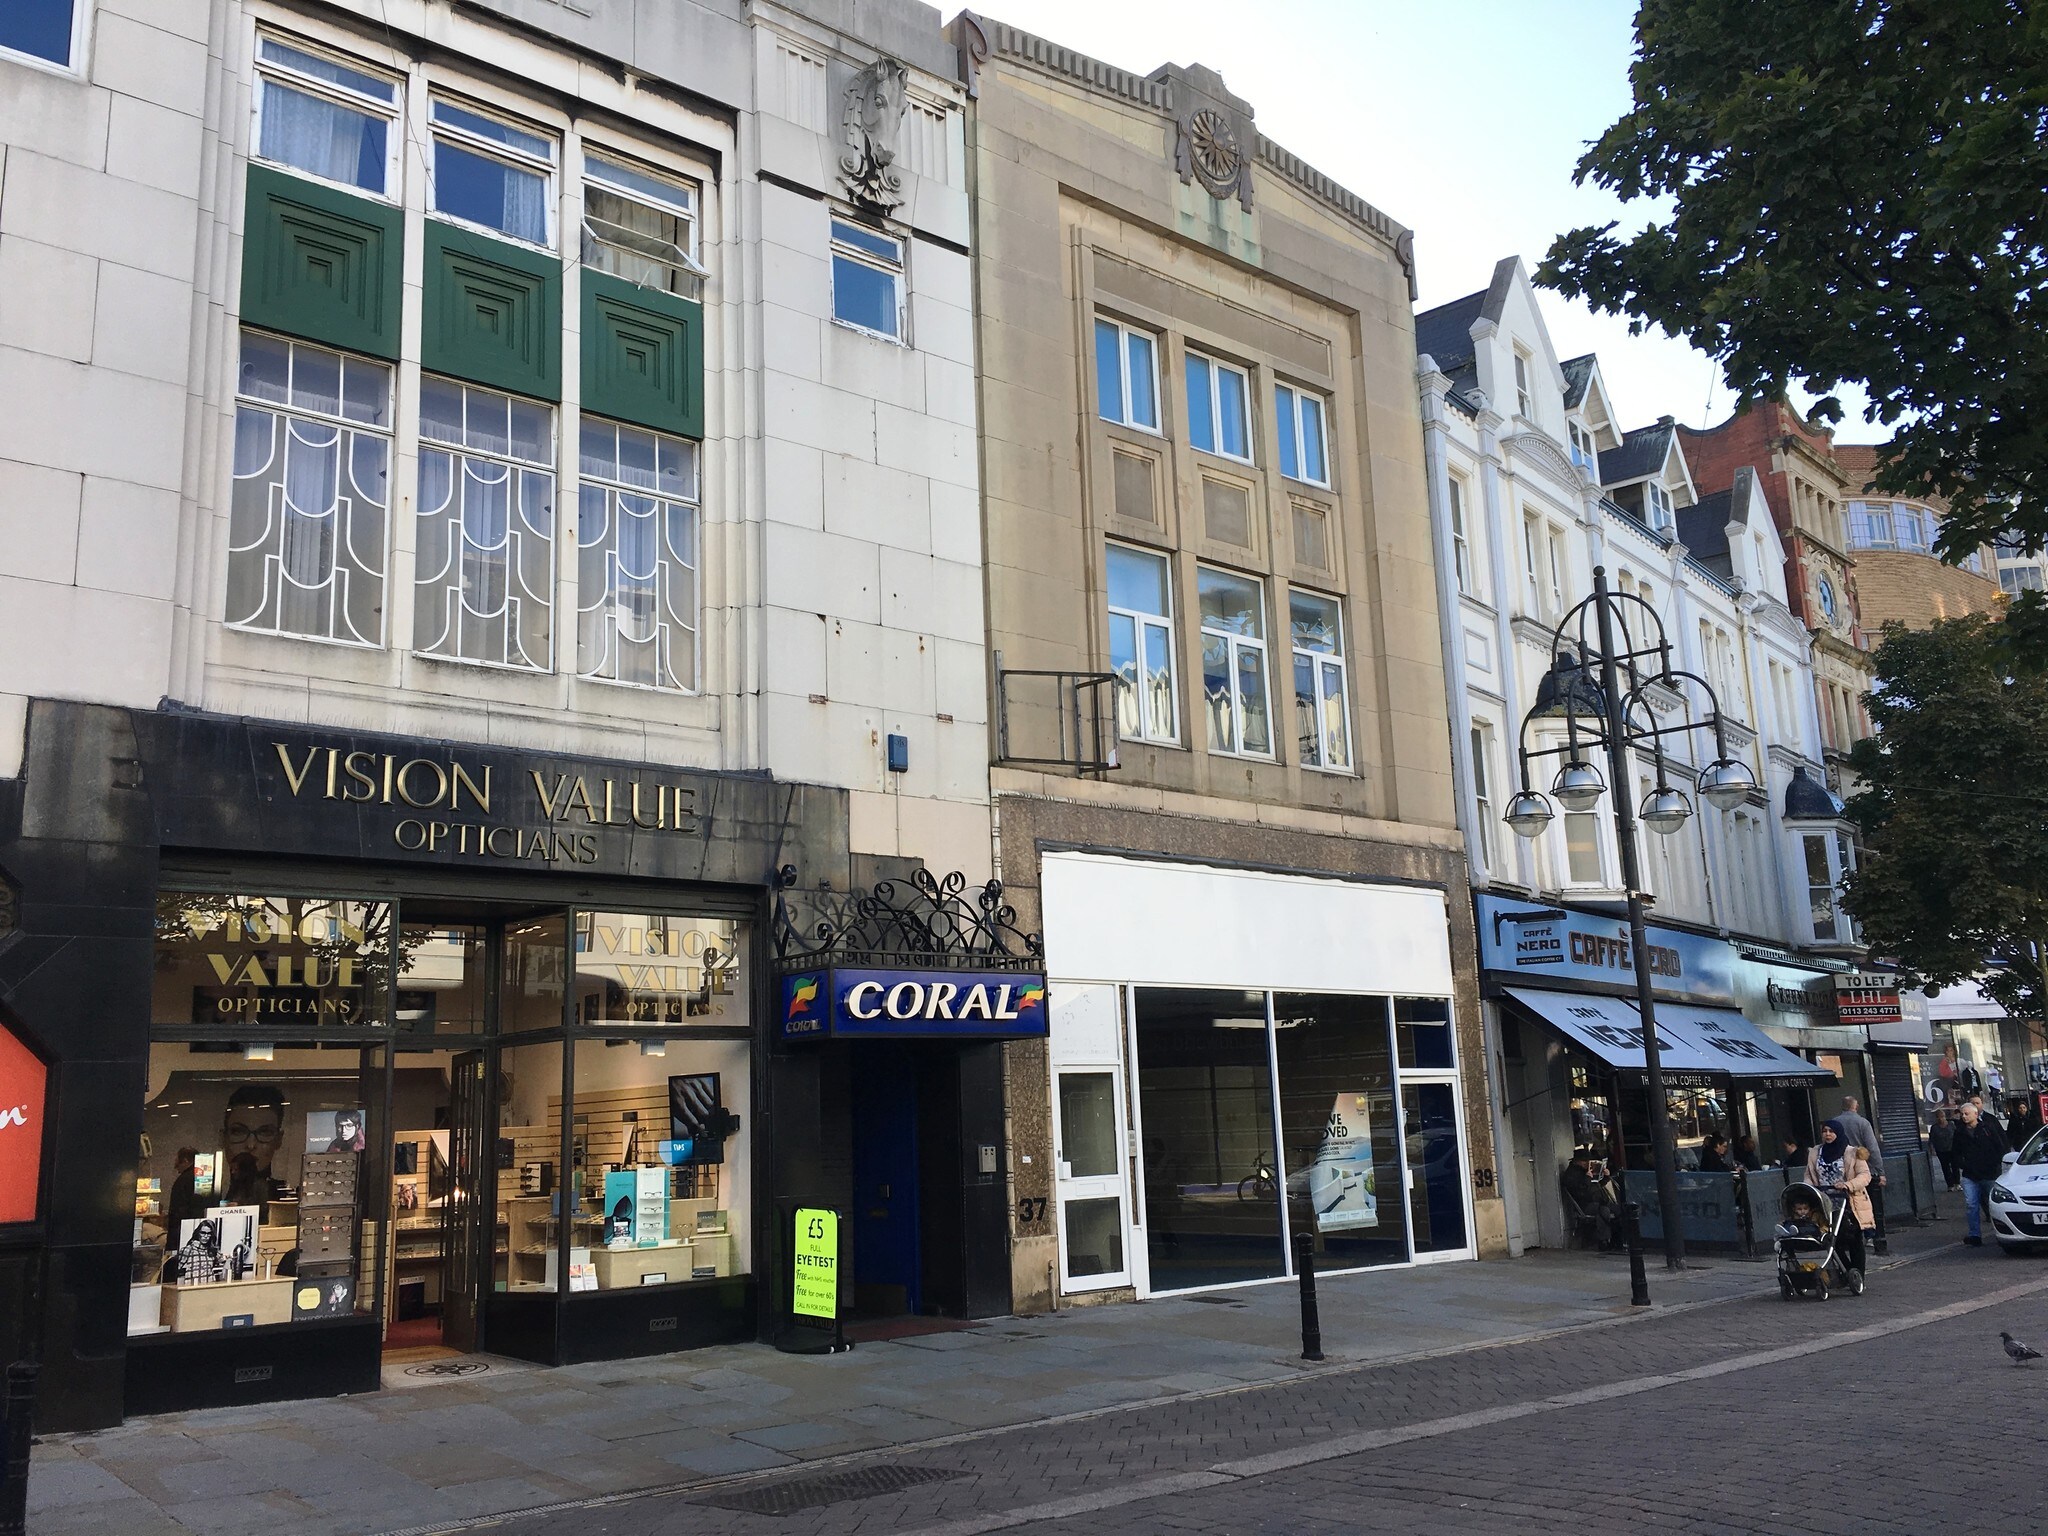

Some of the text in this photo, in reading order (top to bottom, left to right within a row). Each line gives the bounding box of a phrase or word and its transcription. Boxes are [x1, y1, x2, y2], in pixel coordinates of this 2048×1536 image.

[271, 742, 697, 833] VISION VALUE
[394, 820, 599, 864] OPTICIANS
[183, 909, 366, 946] VISION
[596, 925, 738, 961] VISION
[1516, 939, 1560, 952] NERO
[207, 953, 363, 988] VALUE
[1647, 944, 1682, 978] ERO
[616, 964, 734, 996] VALUE
[1846, 976, 1886, 986] TO LET
[217, 997, 351, 1014] OPTICIANS
[846, 981, 1019, 1020] CORAL
[1850, 990, 1887, 1004] LHL
[626, 1001, 725, 1017] OPTICANS
[1641, 1076, 1650, 1085] TH
[1680, 1075, 1702, 1086] COFFEE
[1925, 1078, 1944, 1103] 6
[1475, 1168, 1492, 1187] 39
[1019, 1197, 1047, 1221] 37
[808, 1218, 824, 1239] £5
[810, 1244, 821, 1252] FULL
[797, 1254, 834, 1268] EYE TEST
[796, 1284, 807, 1297] Free
